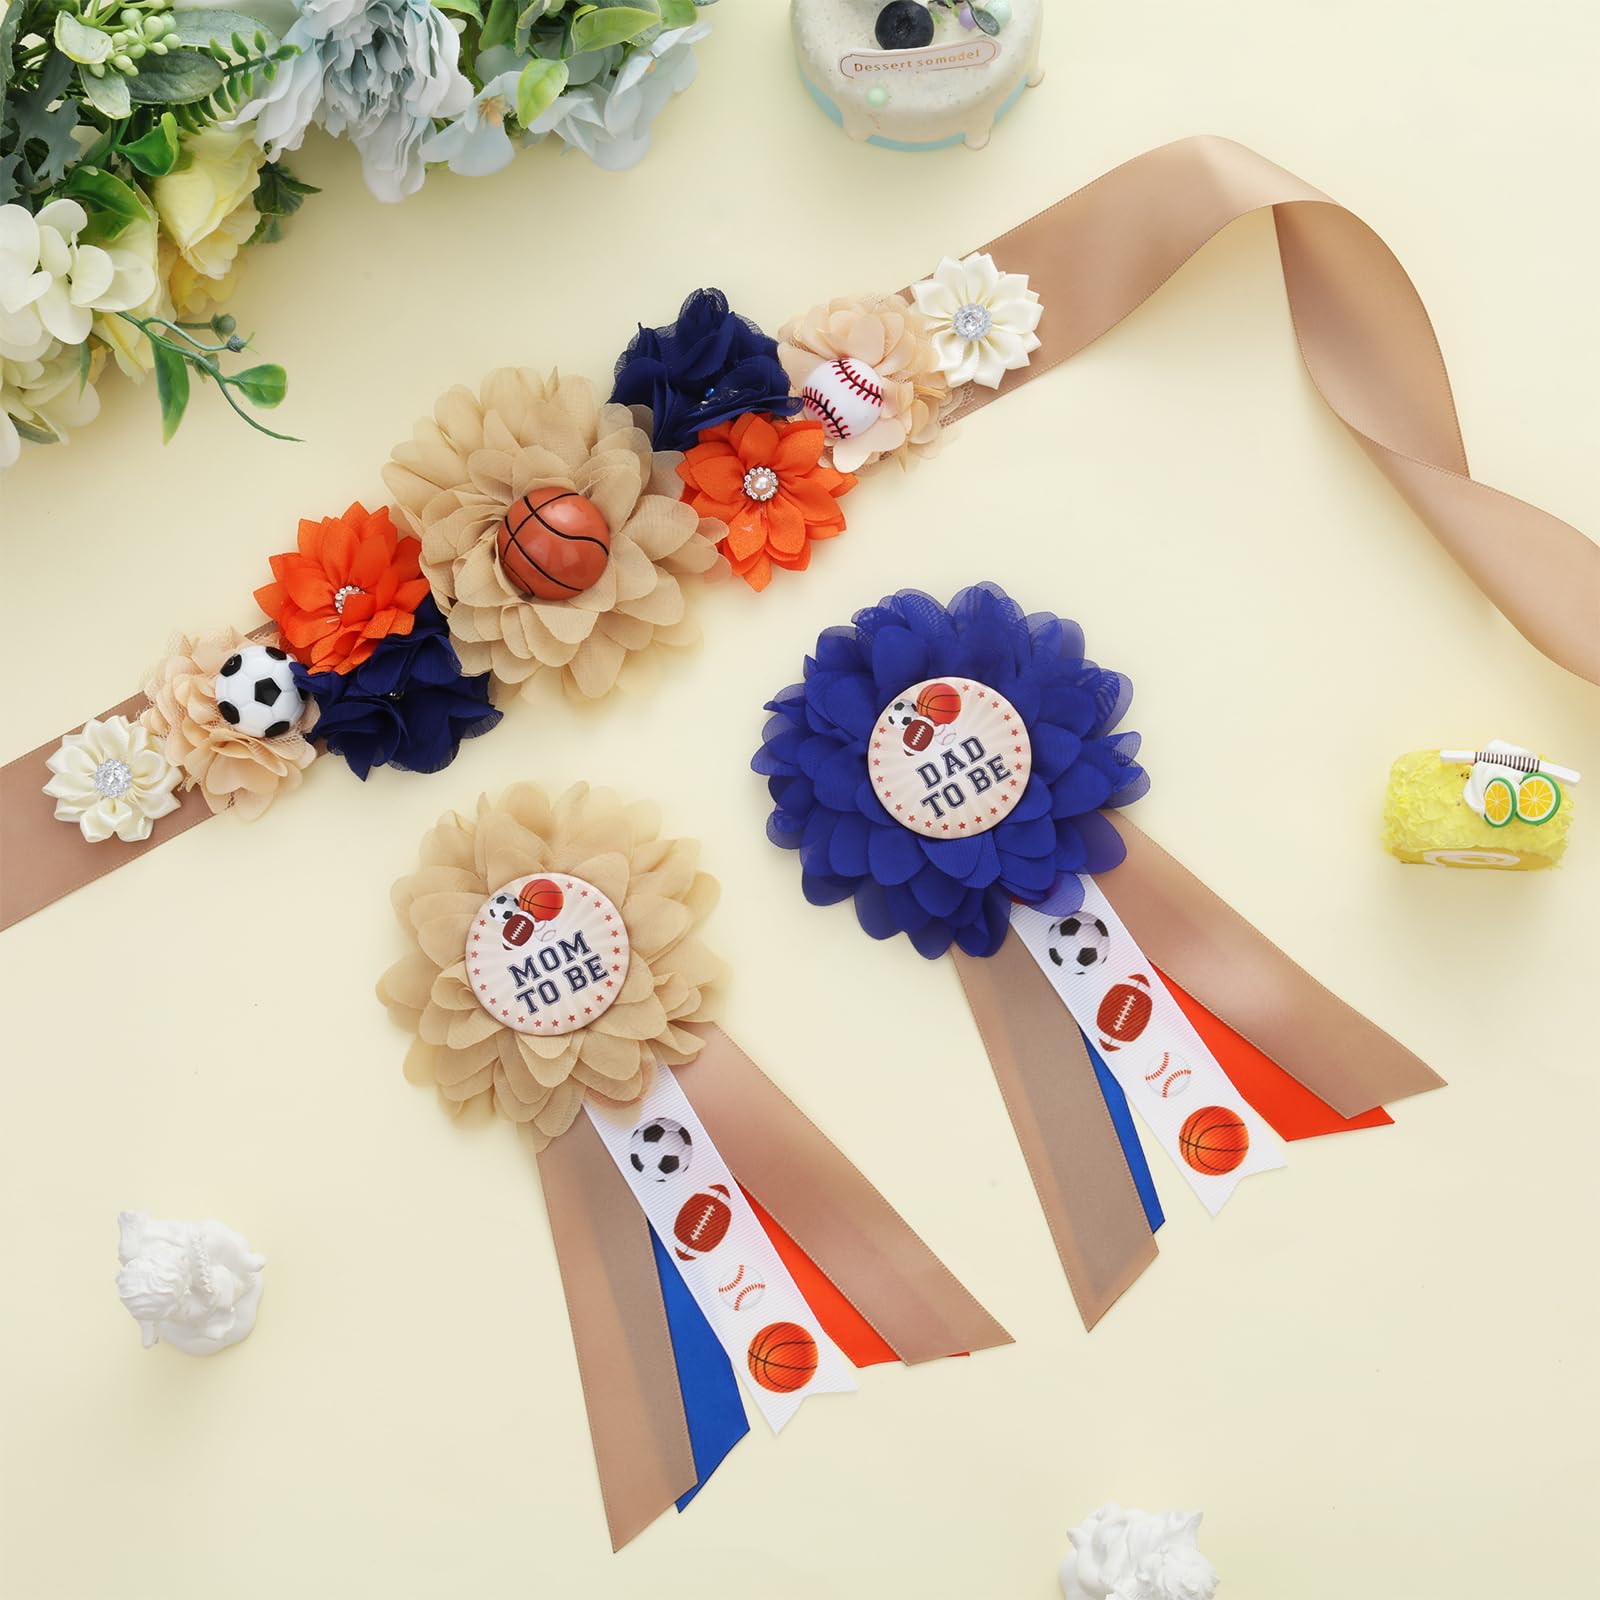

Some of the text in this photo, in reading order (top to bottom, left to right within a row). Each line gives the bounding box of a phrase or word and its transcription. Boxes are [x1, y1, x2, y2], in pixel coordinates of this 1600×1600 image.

[854, 48, 980, 72] Dessert somodel
[916, 735, 987, 790] DAD
[920, 753, 1013, 819] TO BE
[507, 930, 592, 989] MOM
[515, 954, 609, 1015] TO BE
